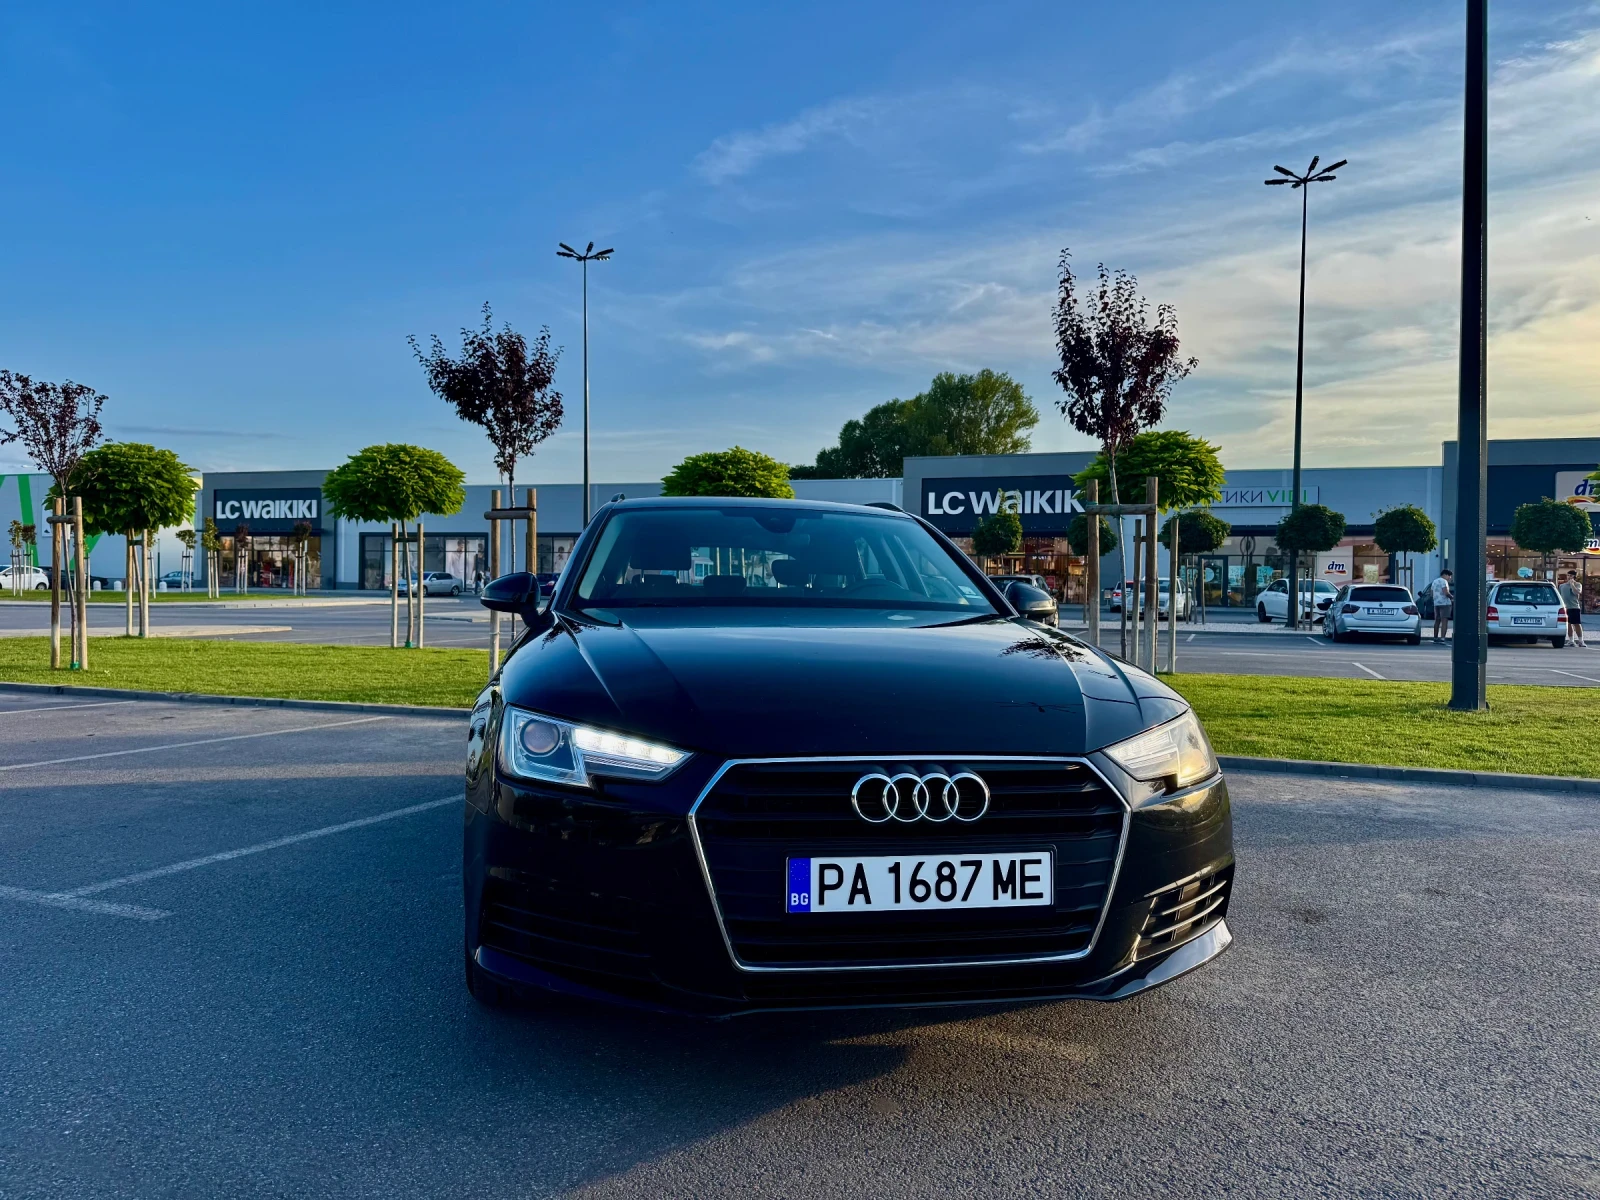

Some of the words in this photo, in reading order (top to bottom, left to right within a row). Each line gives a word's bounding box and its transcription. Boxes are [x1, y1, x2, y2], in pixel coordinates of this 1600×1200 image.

[216, 500, 240, 519] LC
[928, 491, 965, 515] LC
[1328, 560, 1345, 570] dm
[818, 862, 872, 906] PA
[888, 860, 983, 904] 1687
[993, 859, 1044, 901] ME
[791, 892, 809, 906] BG
